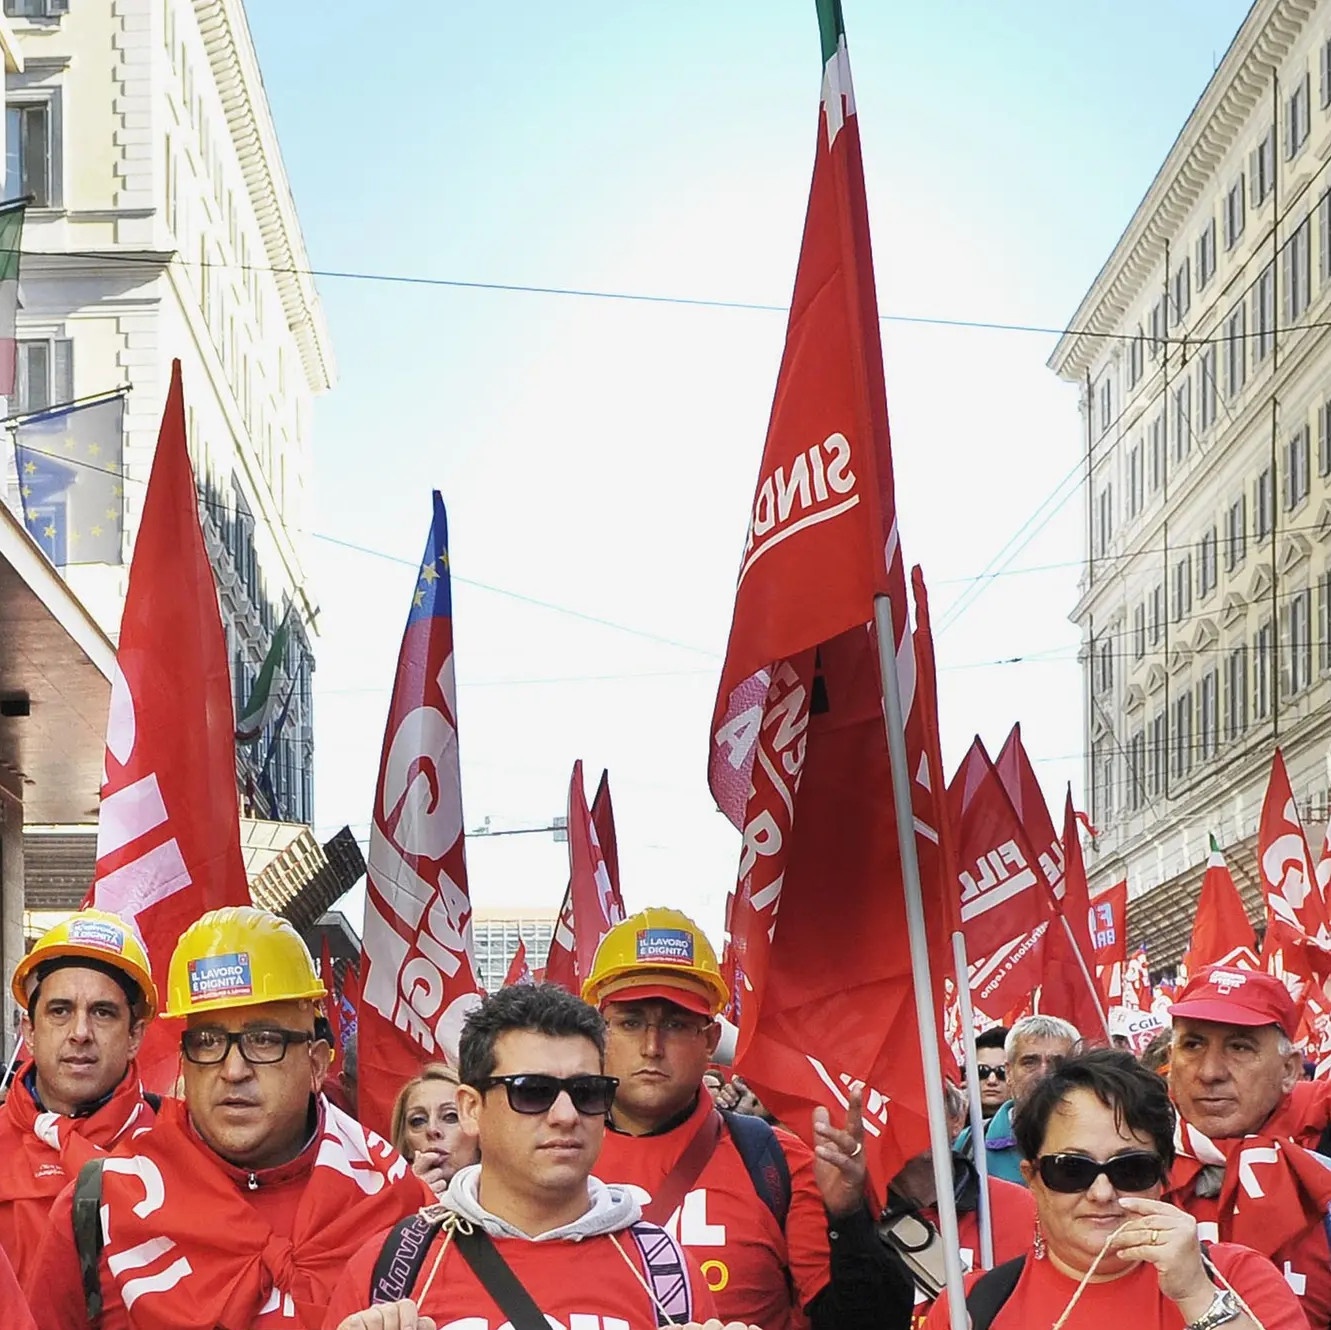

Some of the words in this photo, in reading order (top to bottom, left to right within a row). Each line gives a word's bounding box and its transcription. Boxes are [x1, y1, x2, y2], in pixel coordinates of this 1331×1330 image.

[640, 939, 648, 947] IL
[650, 938, 688, 949] LAVORO
[191, 972, 200, 981] IL
[201, 966, 243, 979] LAVORO
[200, 975, 244, 990] DIGNITÀ
[1128, 1016, 1163, 1033] CGIL
